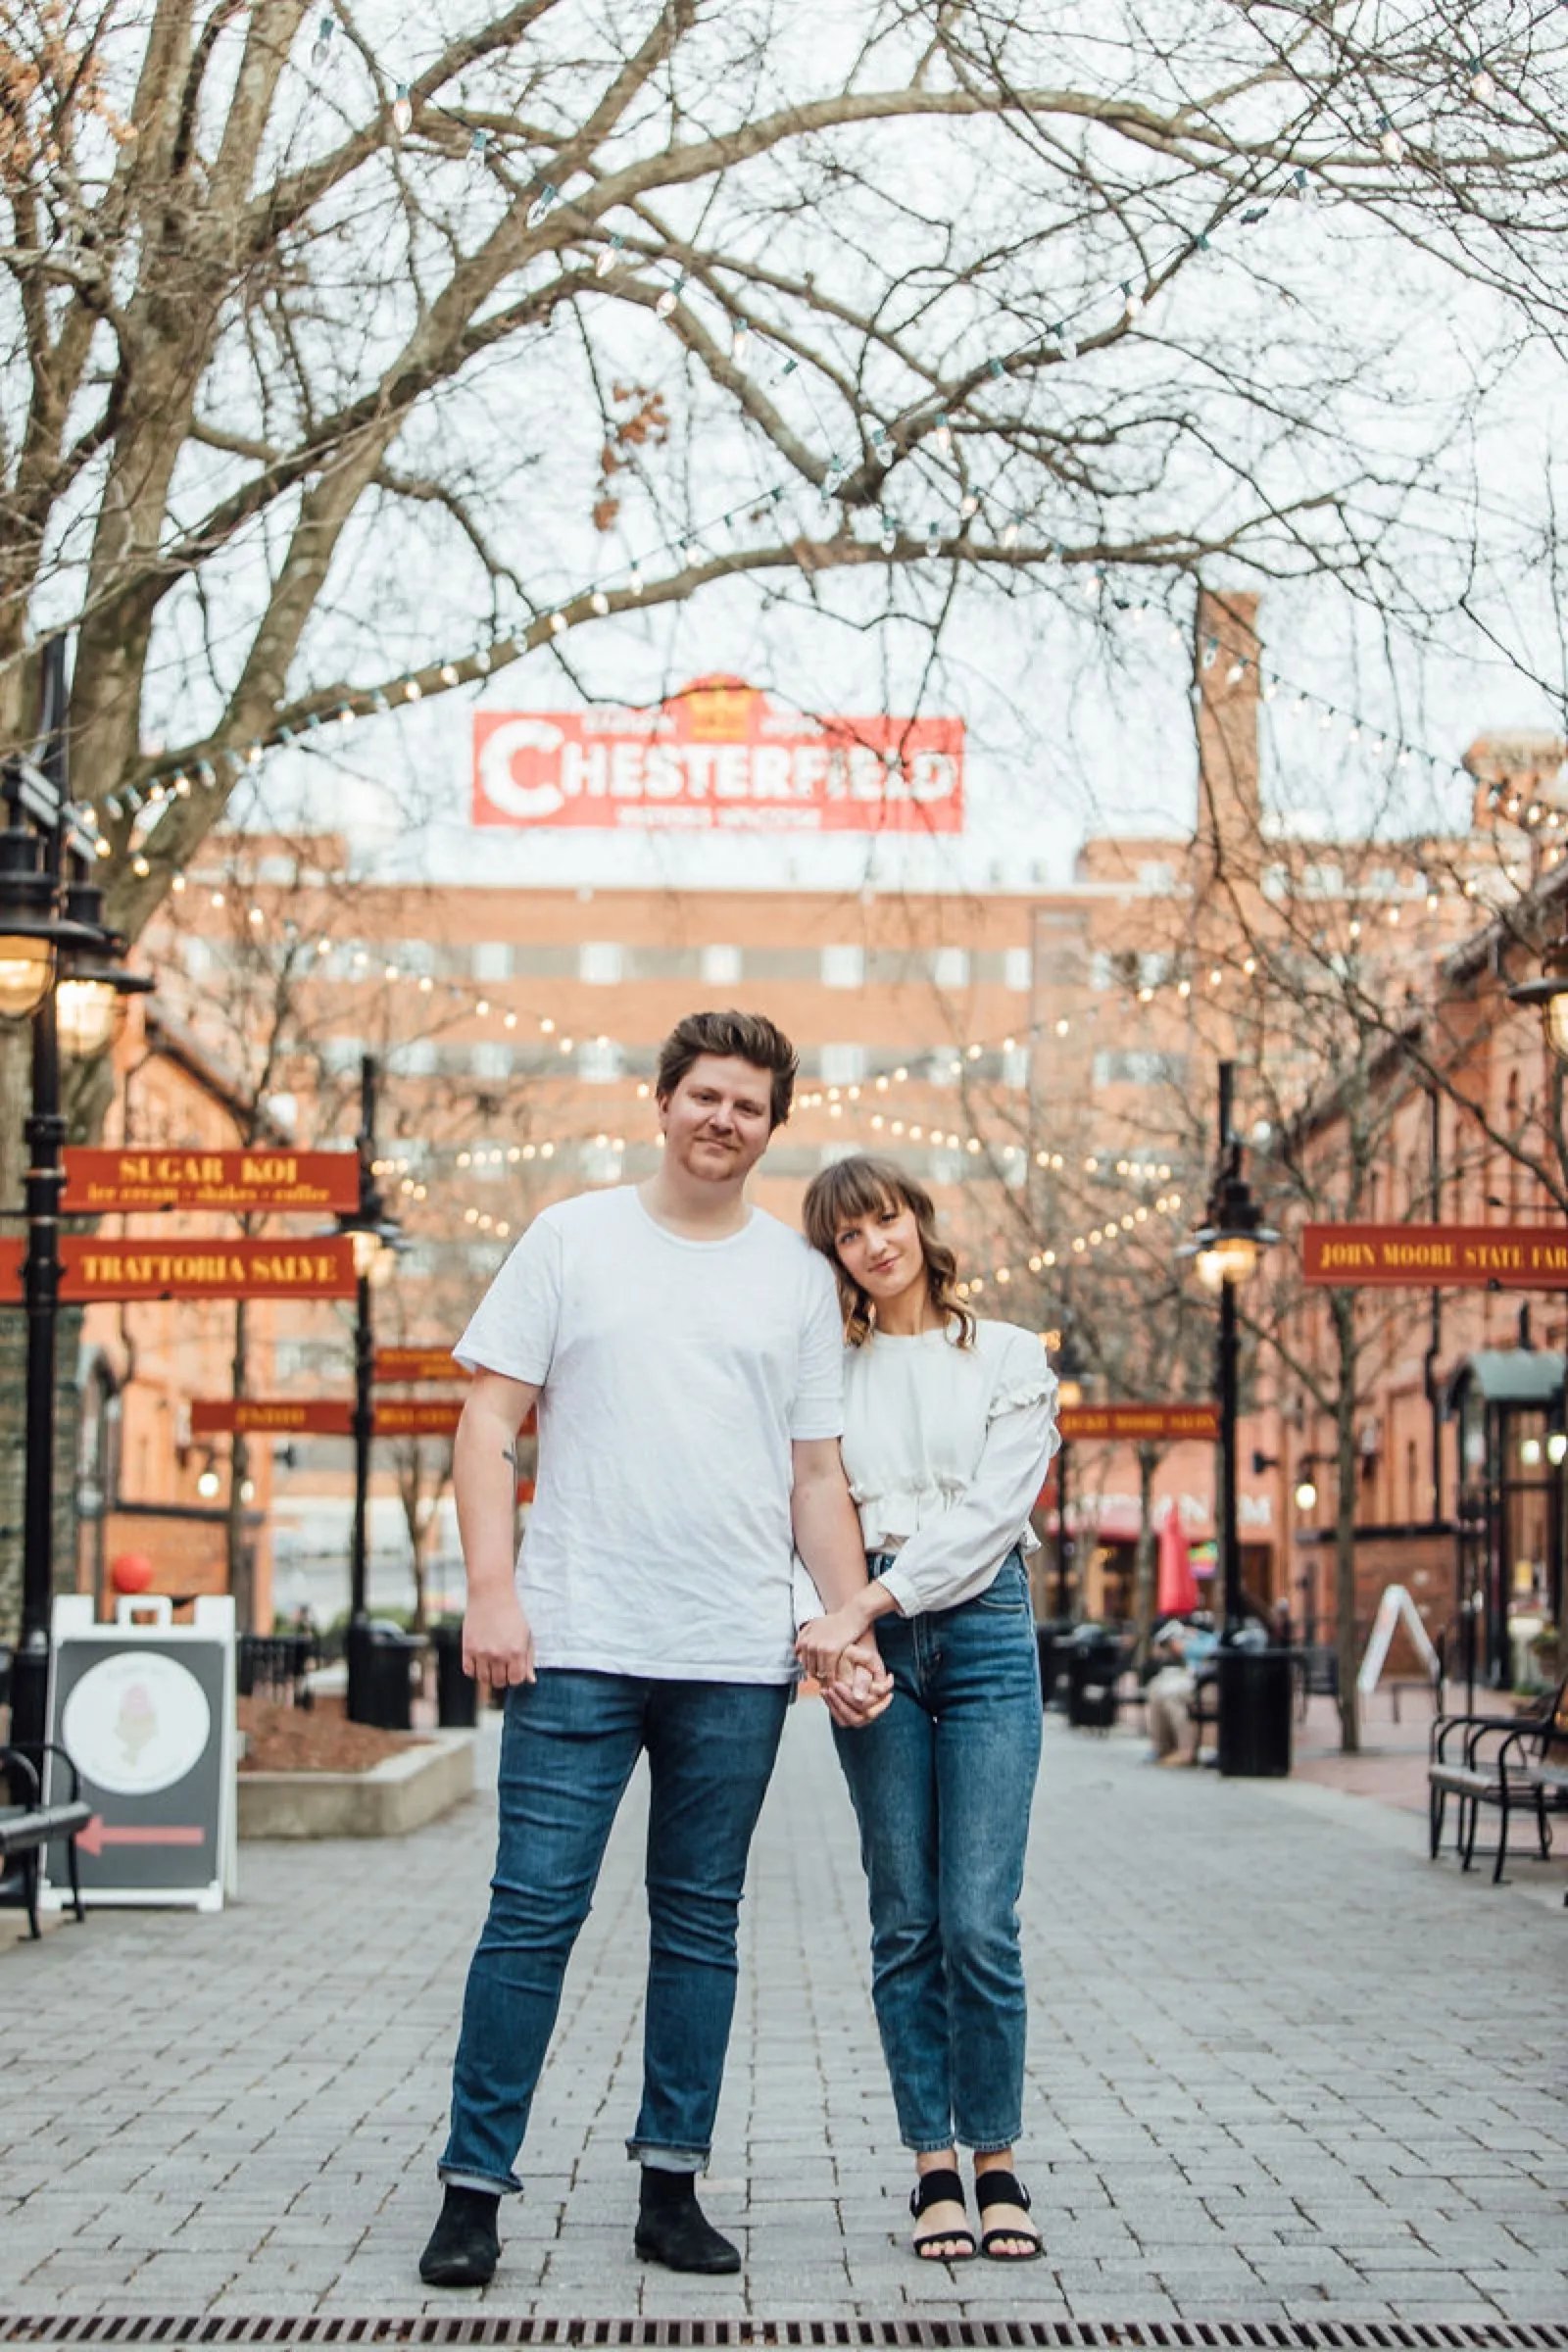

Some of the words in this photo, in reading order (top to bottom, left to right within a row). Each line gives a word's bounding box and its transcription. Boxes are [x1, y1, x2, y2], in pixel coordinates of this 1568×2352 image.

[479, 718, 958, 818] CHESTERFIELD
[119, 1157, 223, 1185] SUGAR
[242, 1158, 298, 1185] KOI
[82, 1255, 245, 1282] TRATTORIA
[252, 1255, 337, 1283] SALVE
[1320, 1244, 1375, 1268] JOHN
[1383, 1244, 1456, 1266] MOORE
[1464, 1246, 1524, 1268] STATE
